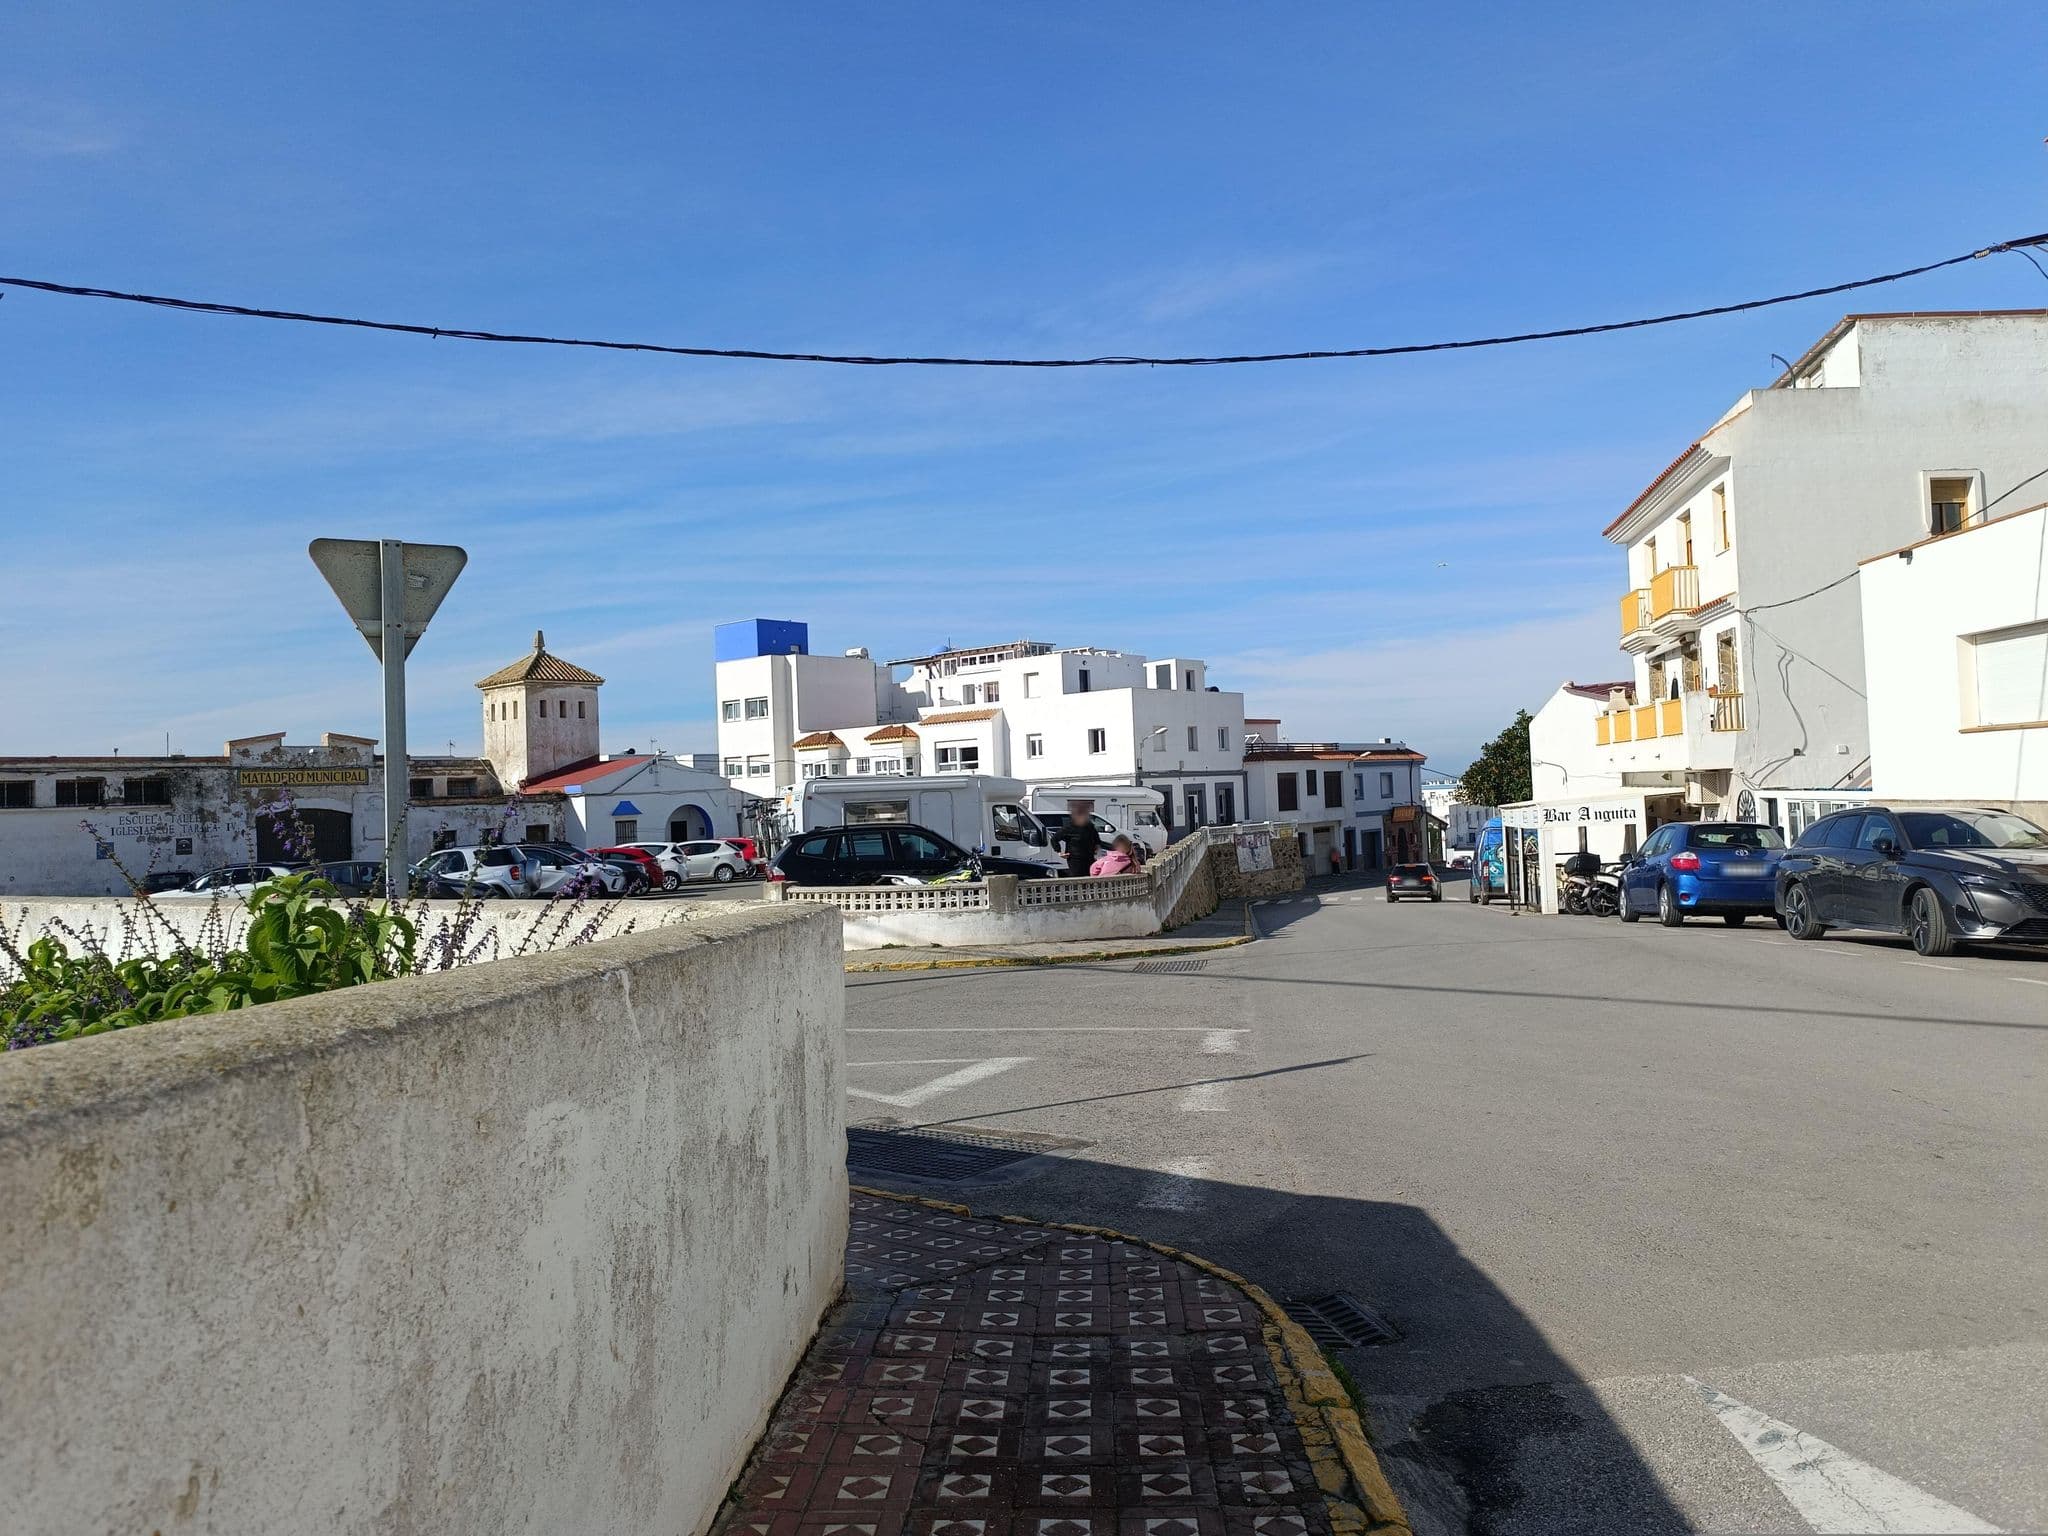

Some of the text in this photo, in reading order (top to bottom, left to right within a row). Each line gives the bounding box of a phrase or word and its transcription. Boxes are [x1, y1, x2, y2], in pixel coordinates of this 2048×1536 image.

[241, 771, 365, 784] MATADERO MUNICIPAL
[119, 815, 162, 826] ESCUELA
[1542, 806, 1637, 824] Bar Anguita
